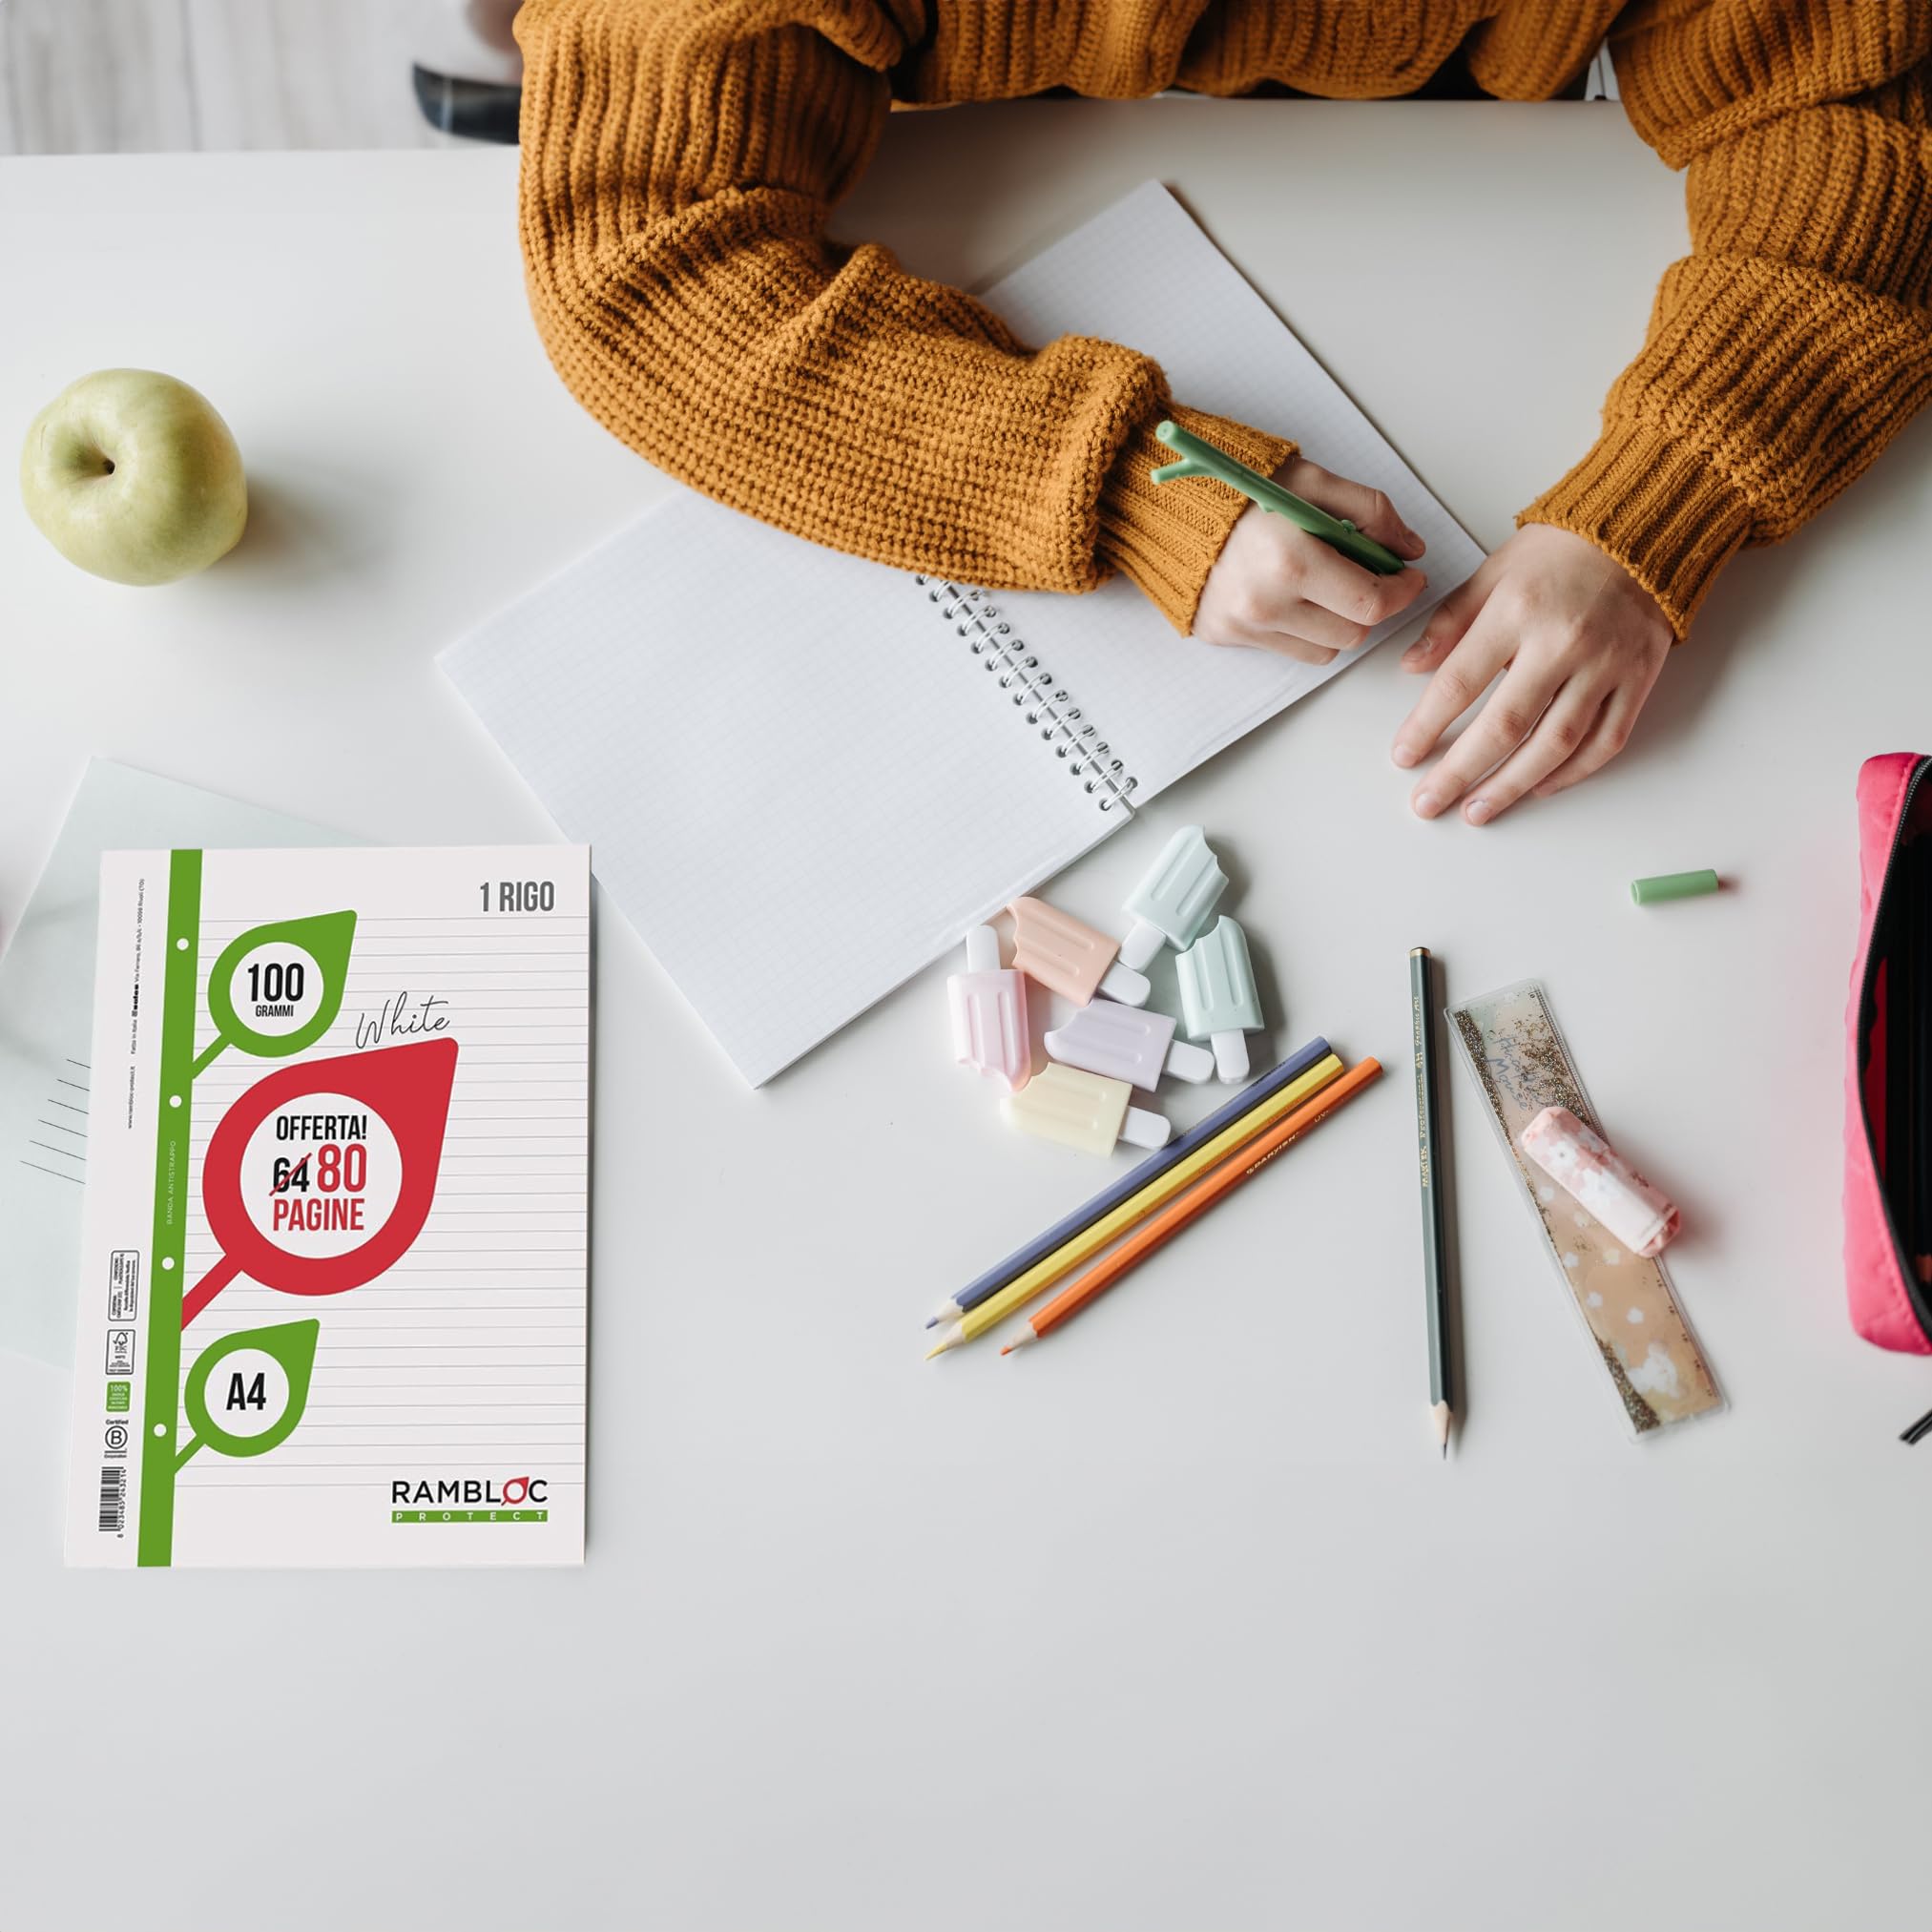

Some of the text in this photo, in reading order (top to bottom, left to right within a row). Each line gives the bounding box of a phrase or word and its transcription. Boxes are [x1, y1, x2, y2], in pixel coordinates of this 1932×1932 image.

[480, 882, 554, 912] 1 RIGO
[247, 963, 304, 1002] 100
[255, 1005, 294, 1018] GRAMMI
[356, 991, 450, 1049] White
[276, 1115, 367, 1141] OFFERTA!
[167, 1140, 177, 1195] ANTISTRAPPO
[272, 1144, 367, 1194] 64 80
[273, 1198, 364, 1232] PAGINE
[225, 1372, 267, 1411] A4
[111, 1430, 122, 1445] B
[392, 1478, 548, 1506] RAMBLOC
[396, 1511, 545, 1522] PROTECT
